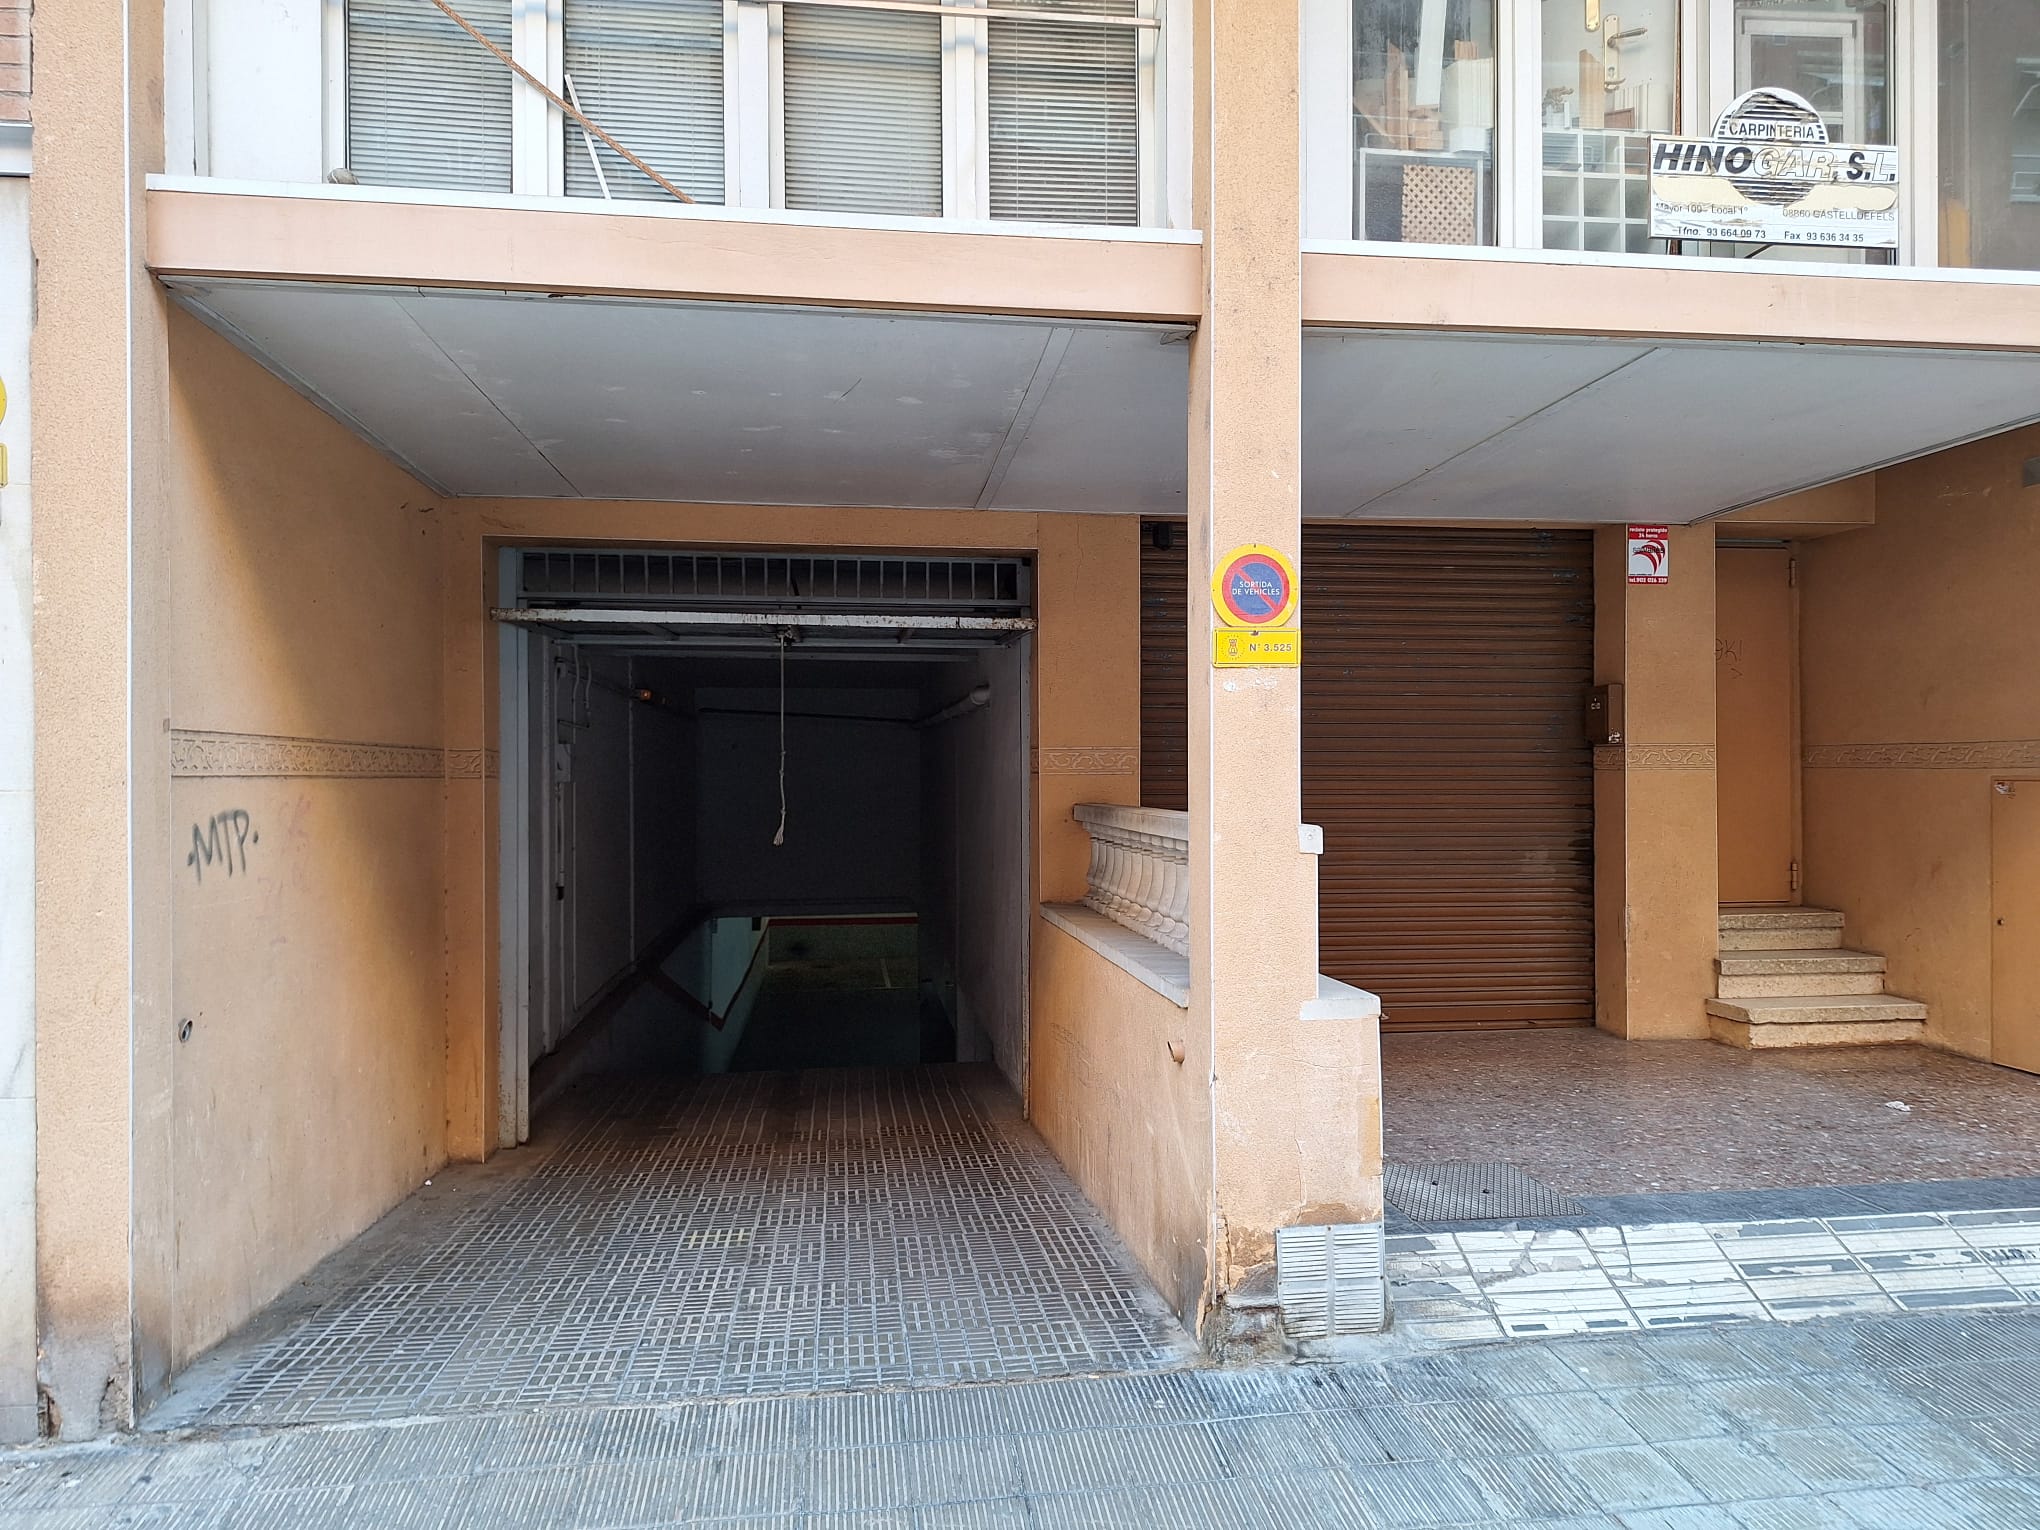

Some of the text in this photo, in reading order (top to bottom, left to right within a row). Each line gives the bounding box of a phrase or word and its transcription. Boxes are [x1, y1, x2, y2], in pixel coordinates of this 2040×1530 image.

[1729, 122, 1814, 139] CARPINTERIA
[1711, 203, 1736, 215] Local
[1706, 227, 1718, 237] 93
[1720, 228, 1737, 238] 664
[1754, 229, 1766, 239] 73
[1784, 231, 1864, 243] Fax 93 636 34 35
[1244, 588, 1280, 596] VEHICLES
[1263, 643, 1292, 652] 3.525
